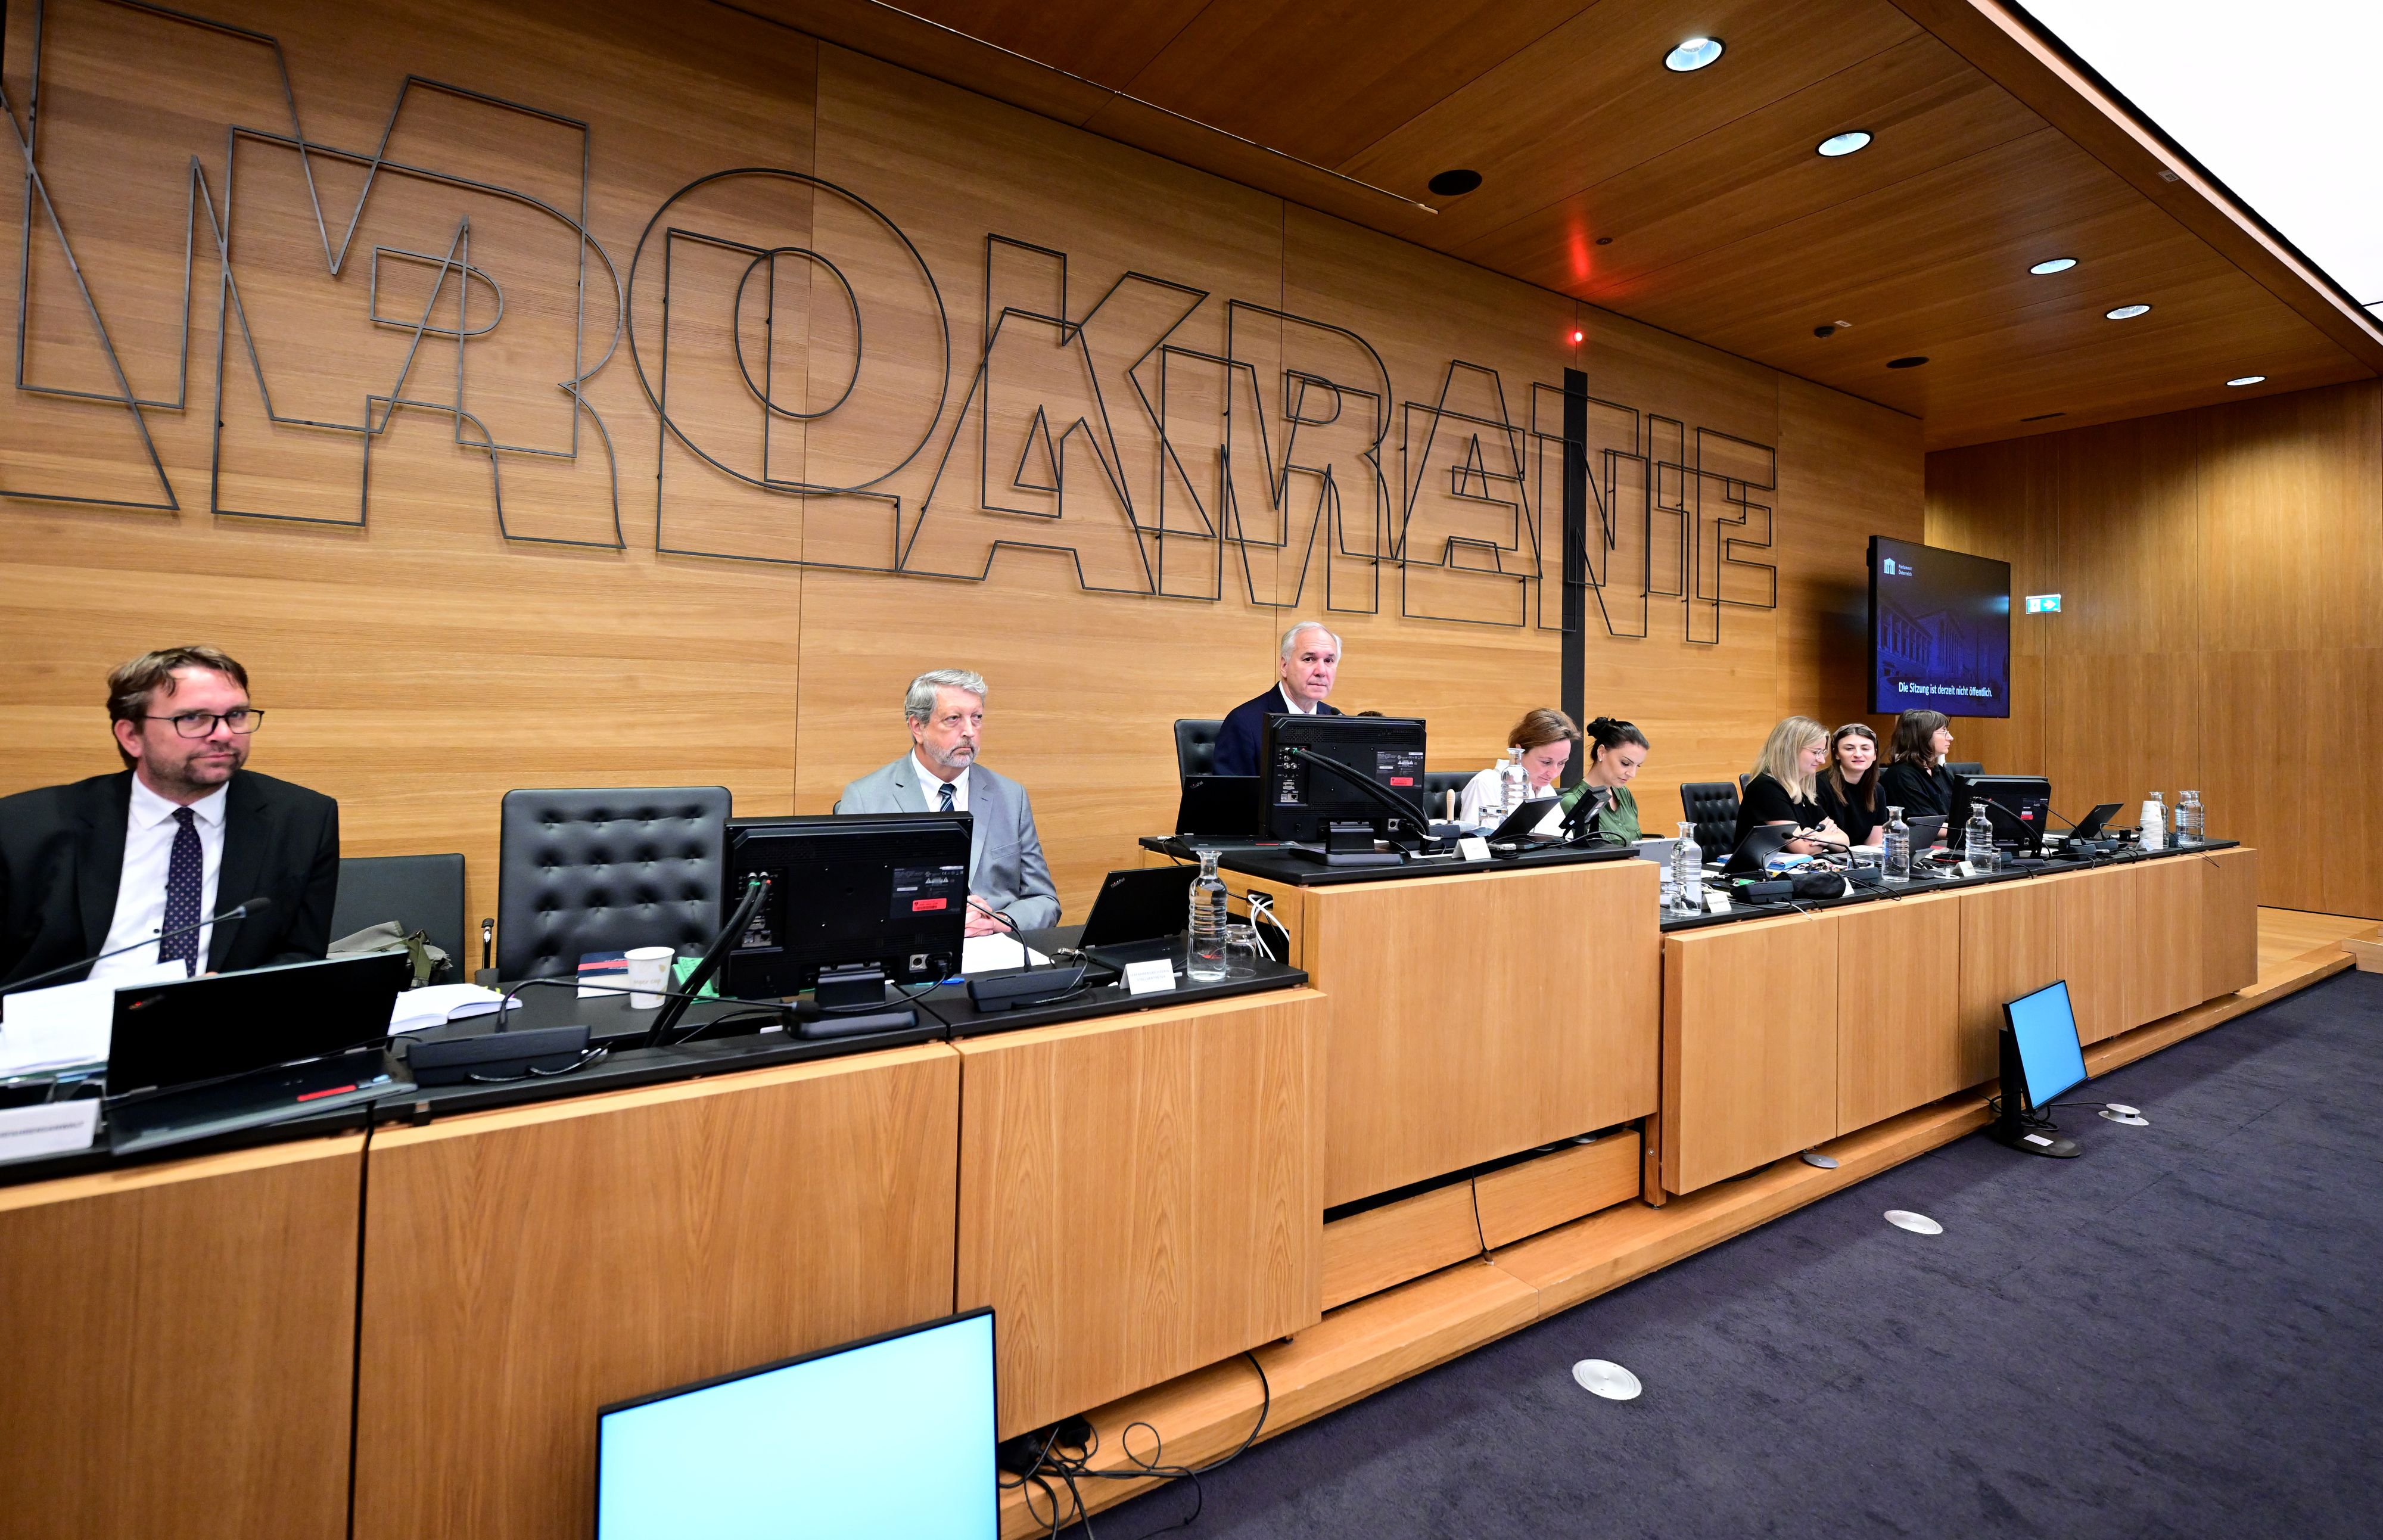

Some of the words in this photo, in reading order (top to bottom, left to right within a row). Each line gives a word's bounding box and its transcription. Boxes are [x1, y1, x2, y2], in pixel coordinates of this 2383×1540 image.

[1899, 682, 1909, 692] Die
[1909, 683, 1930, 696] Sitzung
[1937, 685, 1956, 695] derzeit
[1956, 686, 1968, 696] nicht
[1969, 686, 1993, 697] öffentlich.
